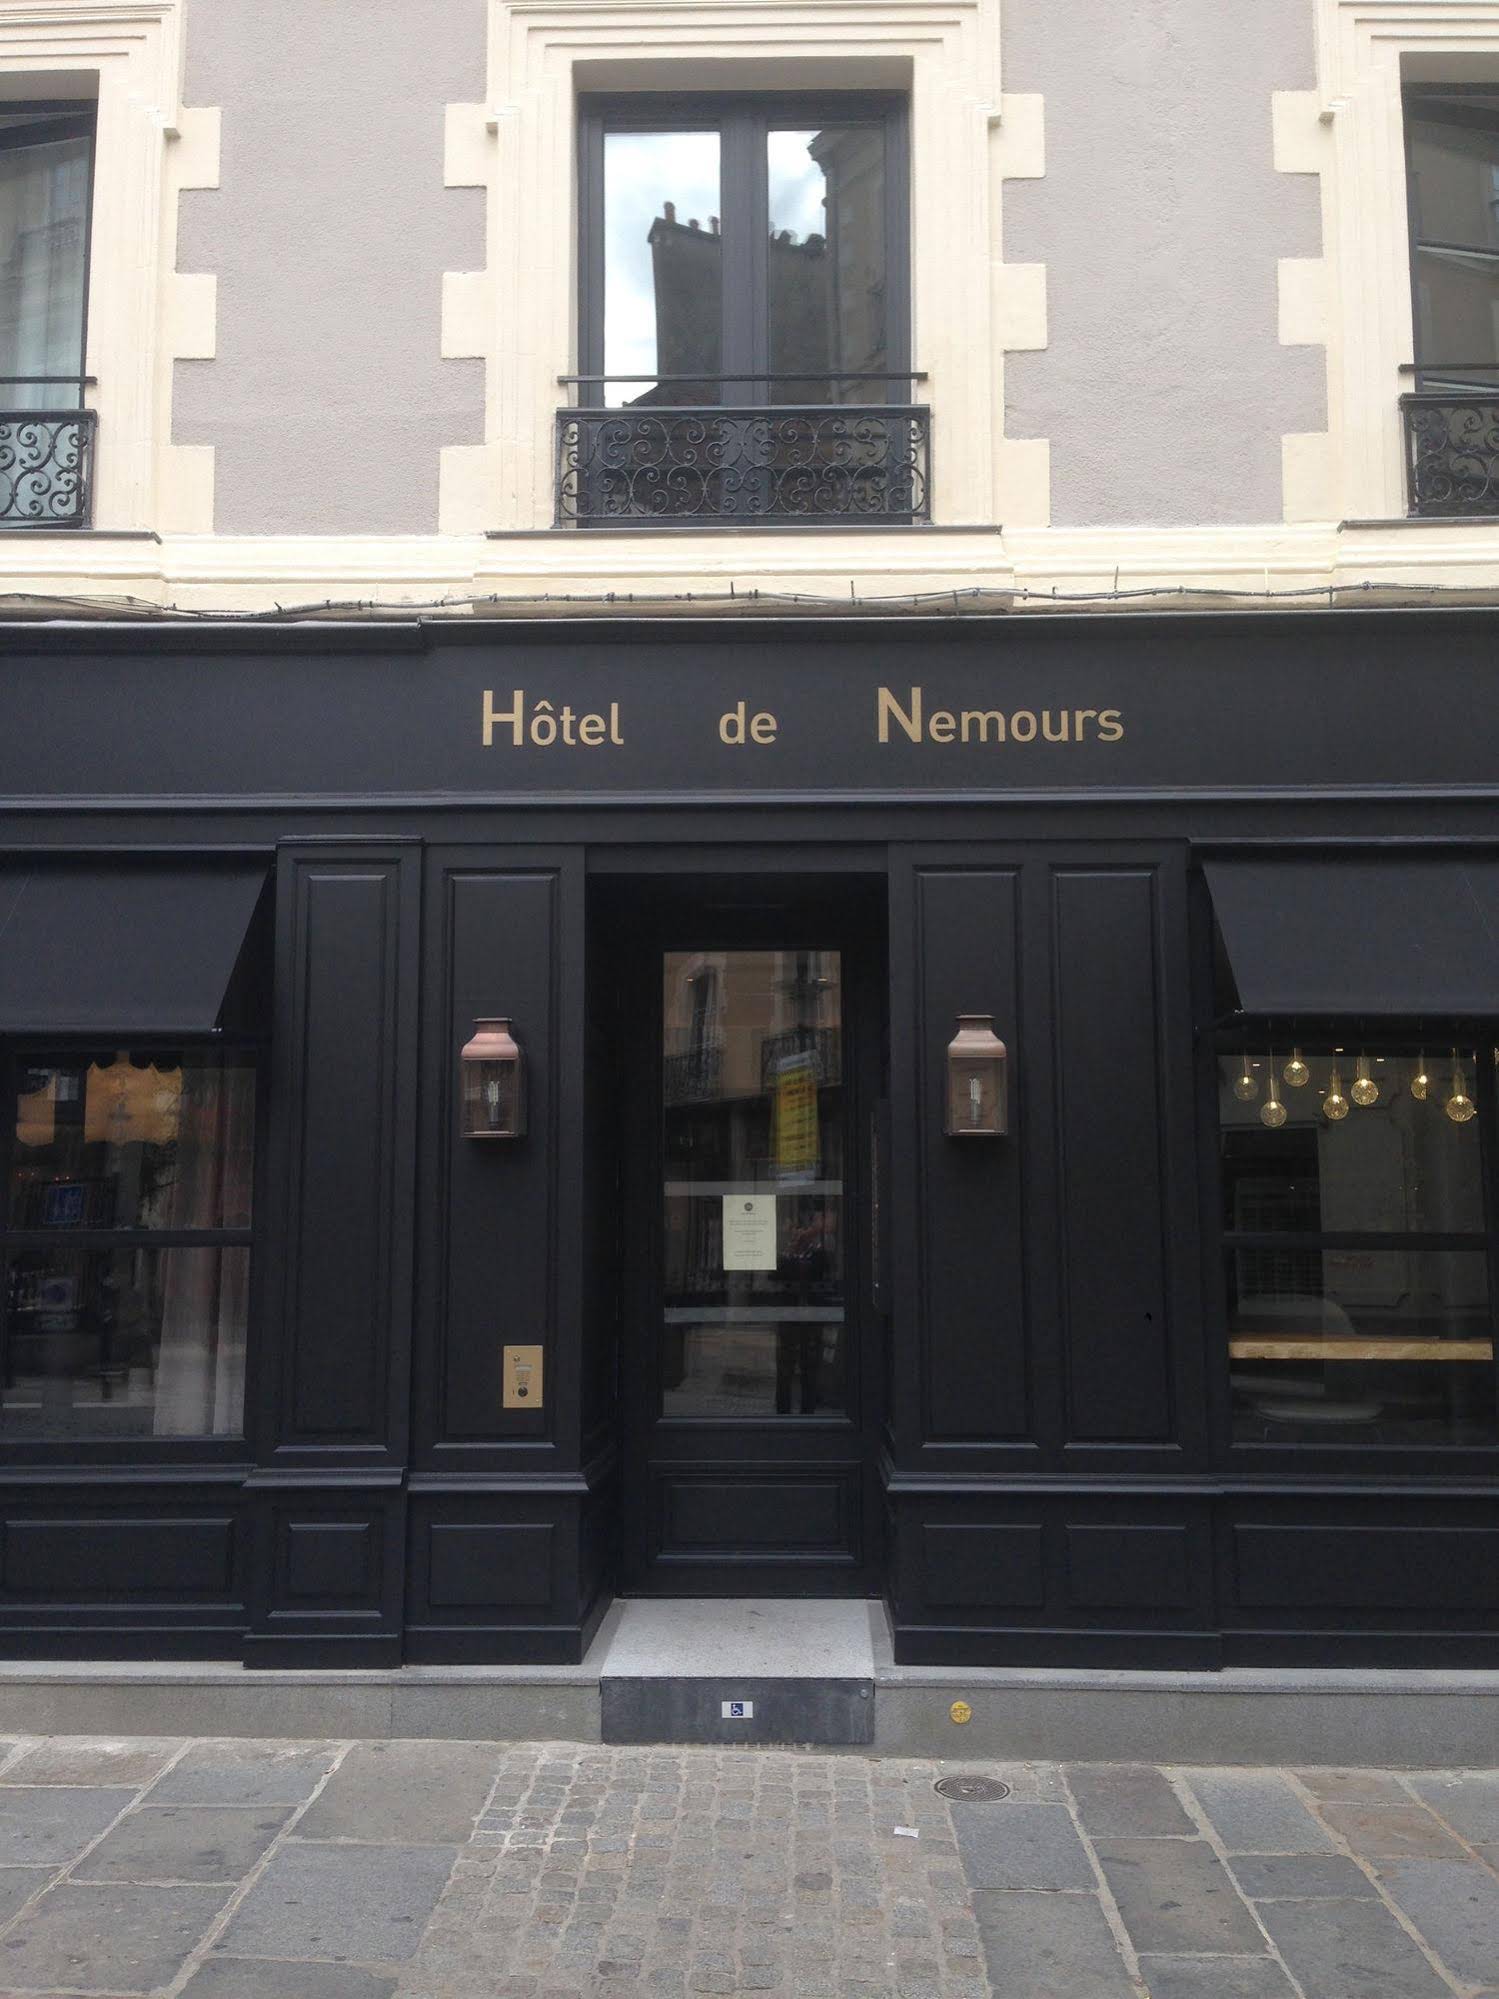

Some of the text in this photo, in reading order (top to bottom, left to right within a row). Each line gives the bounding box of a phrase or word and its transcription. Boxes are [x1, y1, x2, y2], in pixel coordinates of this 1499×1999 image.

[482, 686, 1124, 746] Hôtel de Nemours
